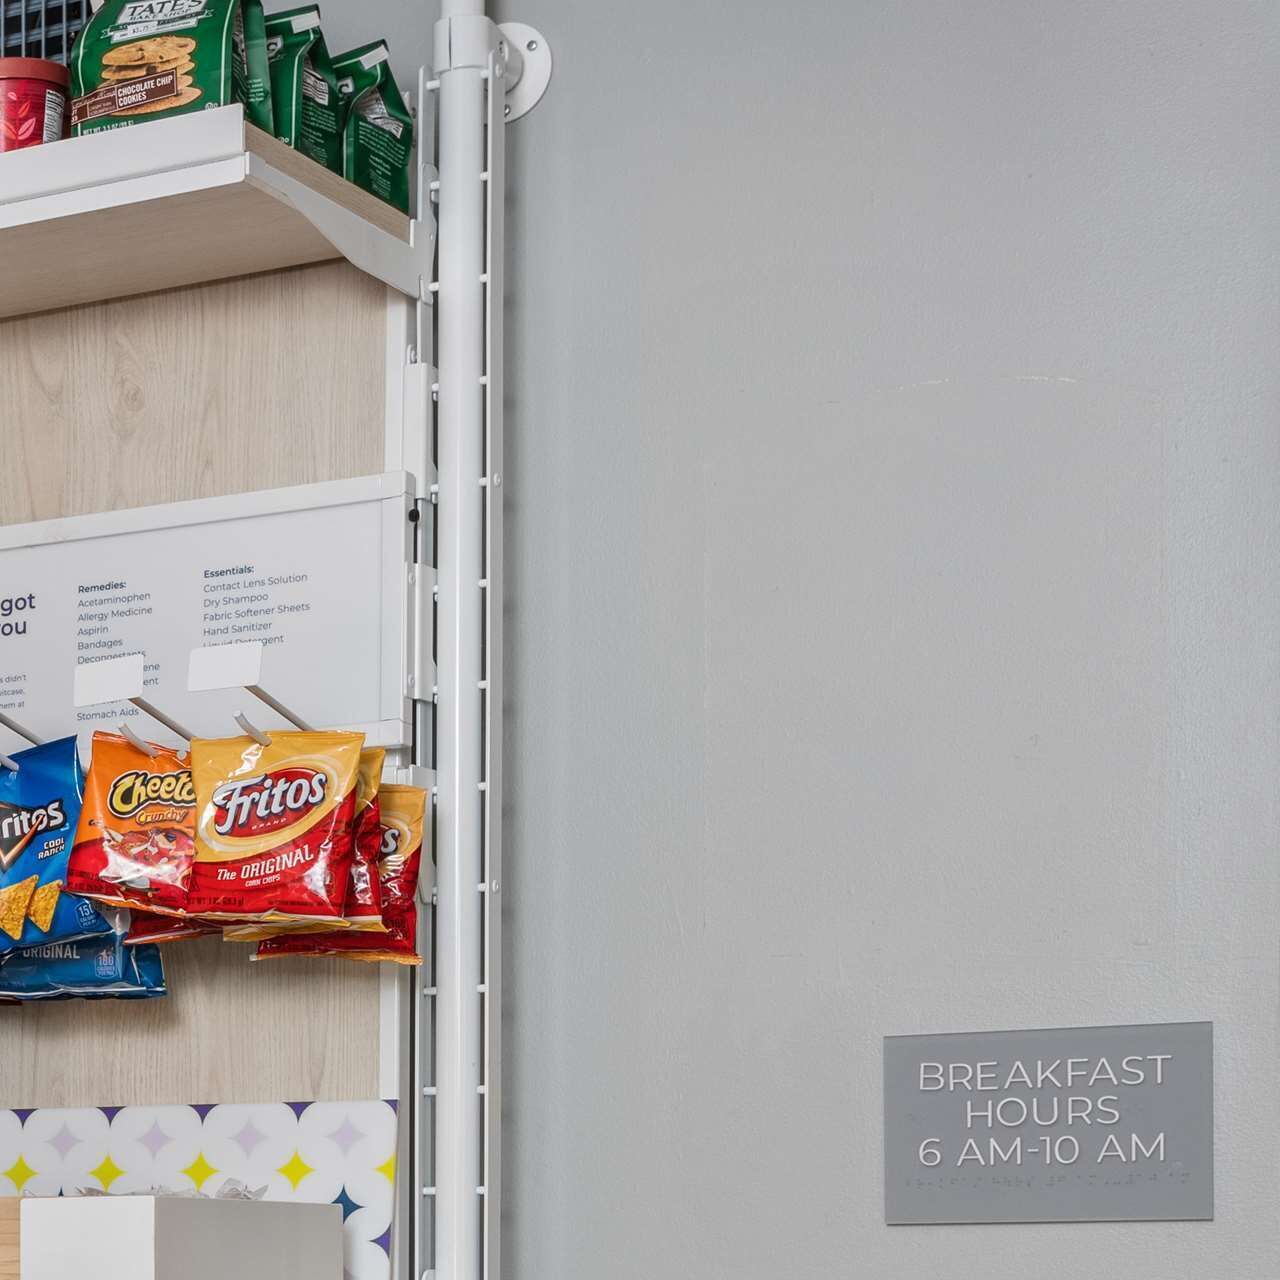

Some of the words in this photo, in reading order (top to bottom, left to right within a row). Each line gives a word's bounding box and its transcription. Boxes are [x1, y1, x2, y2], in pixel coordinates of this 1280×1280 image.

[117, 79, 156, 96] CHOCOLATE
[156, 75, 173, 87] CHIP
[118, 92, 147, 107] COOKIES
[203, 564, 255, 579] Essentials:
[77, 581, 127, 594] Remedies:
[203, 581, 241, 594] Contact
[243, 578, 266, 590] Lens
[267, 573, 308, 586] Solution
[0, 593, 36, 617] got
[77, 592, 151, 608] Acetaminophen
[203, 598, 220, 610] Dry
[222, 593, 269, 607] Shampoo
[77, 610, 109, 623] Allergy
[110, 606, 153, 619] Medicine
[203, 609, 232, 622] Fabric
[234, 606, 275, 620] Softener
[277, 602, 311, 613] Sheets
[77, 625, 109, 637] Aspirin
[203, 626, 229, 637] Hand
[231, 621, 272, 634] Sanitizer
[77, 638, 123, 651] Bandages
[4, 674, 27, 684] didn't
[18, 701, 25, 709] at
[76, 709, 117, 721] Stomach
[119, 706, 140, 718] Aids
[213, 772, 328, 835] Fritos
[135, 808, 189, 826] Crunchy
[251, 816, 288, 831] BRAND
[43, 837, 65, 850] COOL
[38, 844, 65, 860] RANCH
[217, 867, 237, 881] The
[241, 844, 315, 879] ORIGINAL
[244, 878, 261, 888] CORN
[262, 875, 281, 886] CHIPS
[23, 944, 80, 959] ORIGINAL
[918, 1054, 1173, 1092] BREAKFAST
[966, 1095, 1121, 1129] HOURS
[918, 1137, 942, 1167] 6
[956, 1135, 1080, 1167] AM-10
[1096, 1132, 1167, 1163] AM
